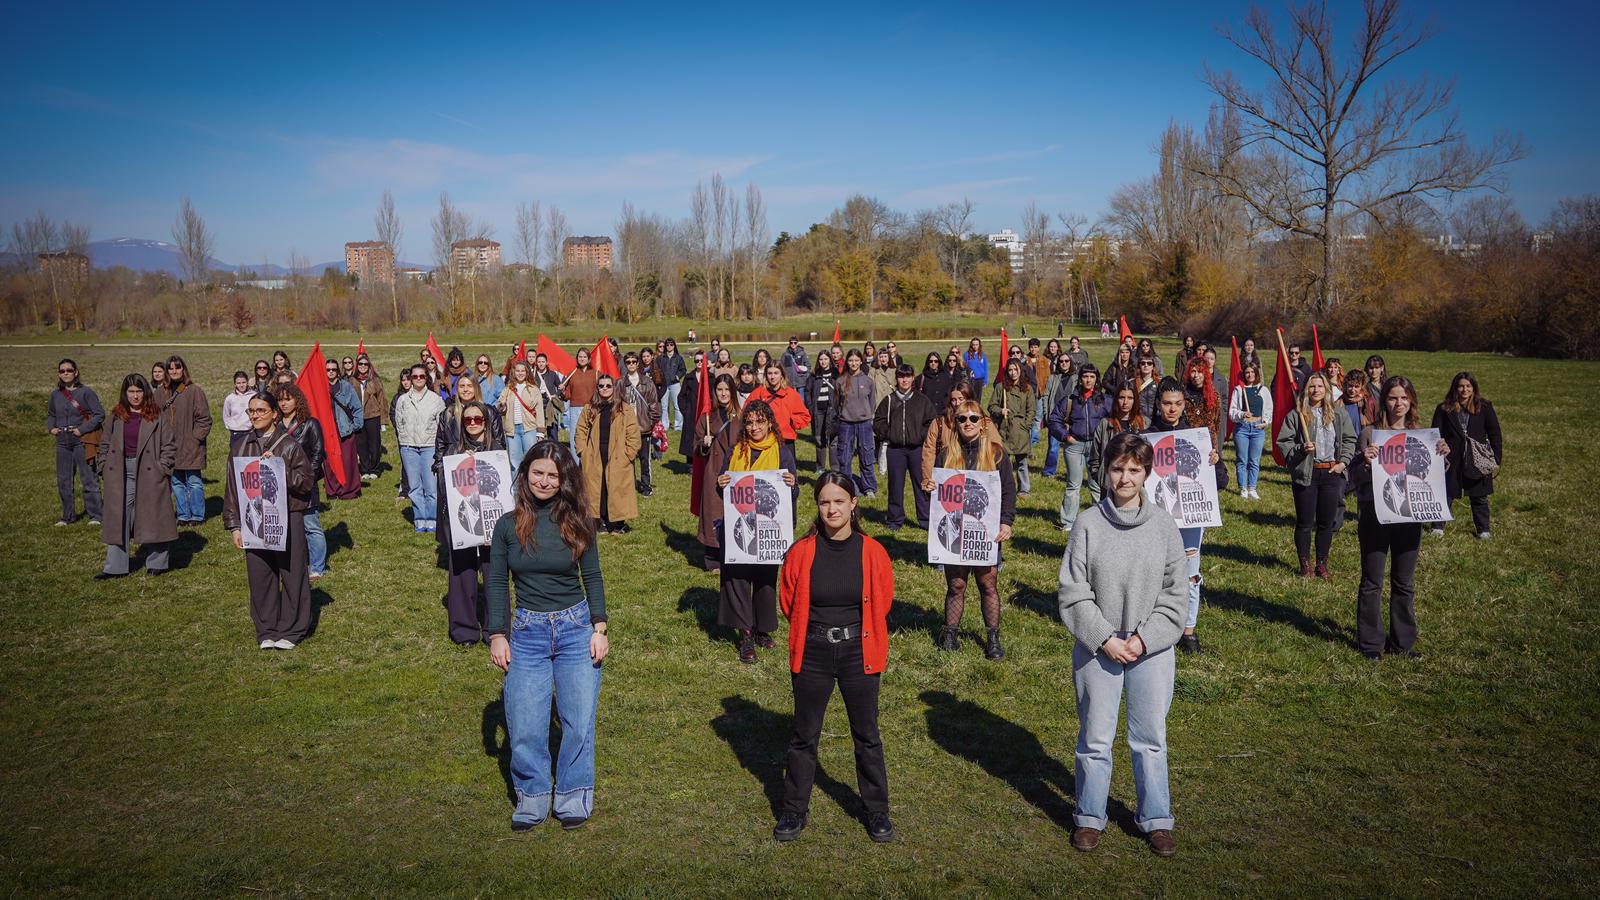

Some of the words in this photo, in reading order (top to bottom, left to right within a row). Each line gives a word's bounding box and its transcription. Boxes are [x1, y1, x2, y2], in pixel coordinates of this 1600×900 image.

[1378, 445, 1405, 465] M8
[240, 472, 260, 489] M8
[451, 467, 476, 488] M8
[730, 486, 754, 504] M8
[937, 483, 964, 503] M8
[1180, 490, 1204, 503] BATU
[1409, 491, 1433, 502] BATU
[1182, 500, 1213, 514] BORRO
[1411, 501, 1442, 513] BORRO
[264, 515, 279, 525] BATU
[1184, 513, 1212, 524] KARA!
[264, 525, 284, 536] BORRO
[758, 529, 780, 539] BATU
[963, 529, 986, 541] BATU
[264, 535, 281, 546] KARA!
[758, 539, 788, 550] BORRO
[962, 540, 992, 551] BORRO
[961, 550, 989, 561] KARA!
